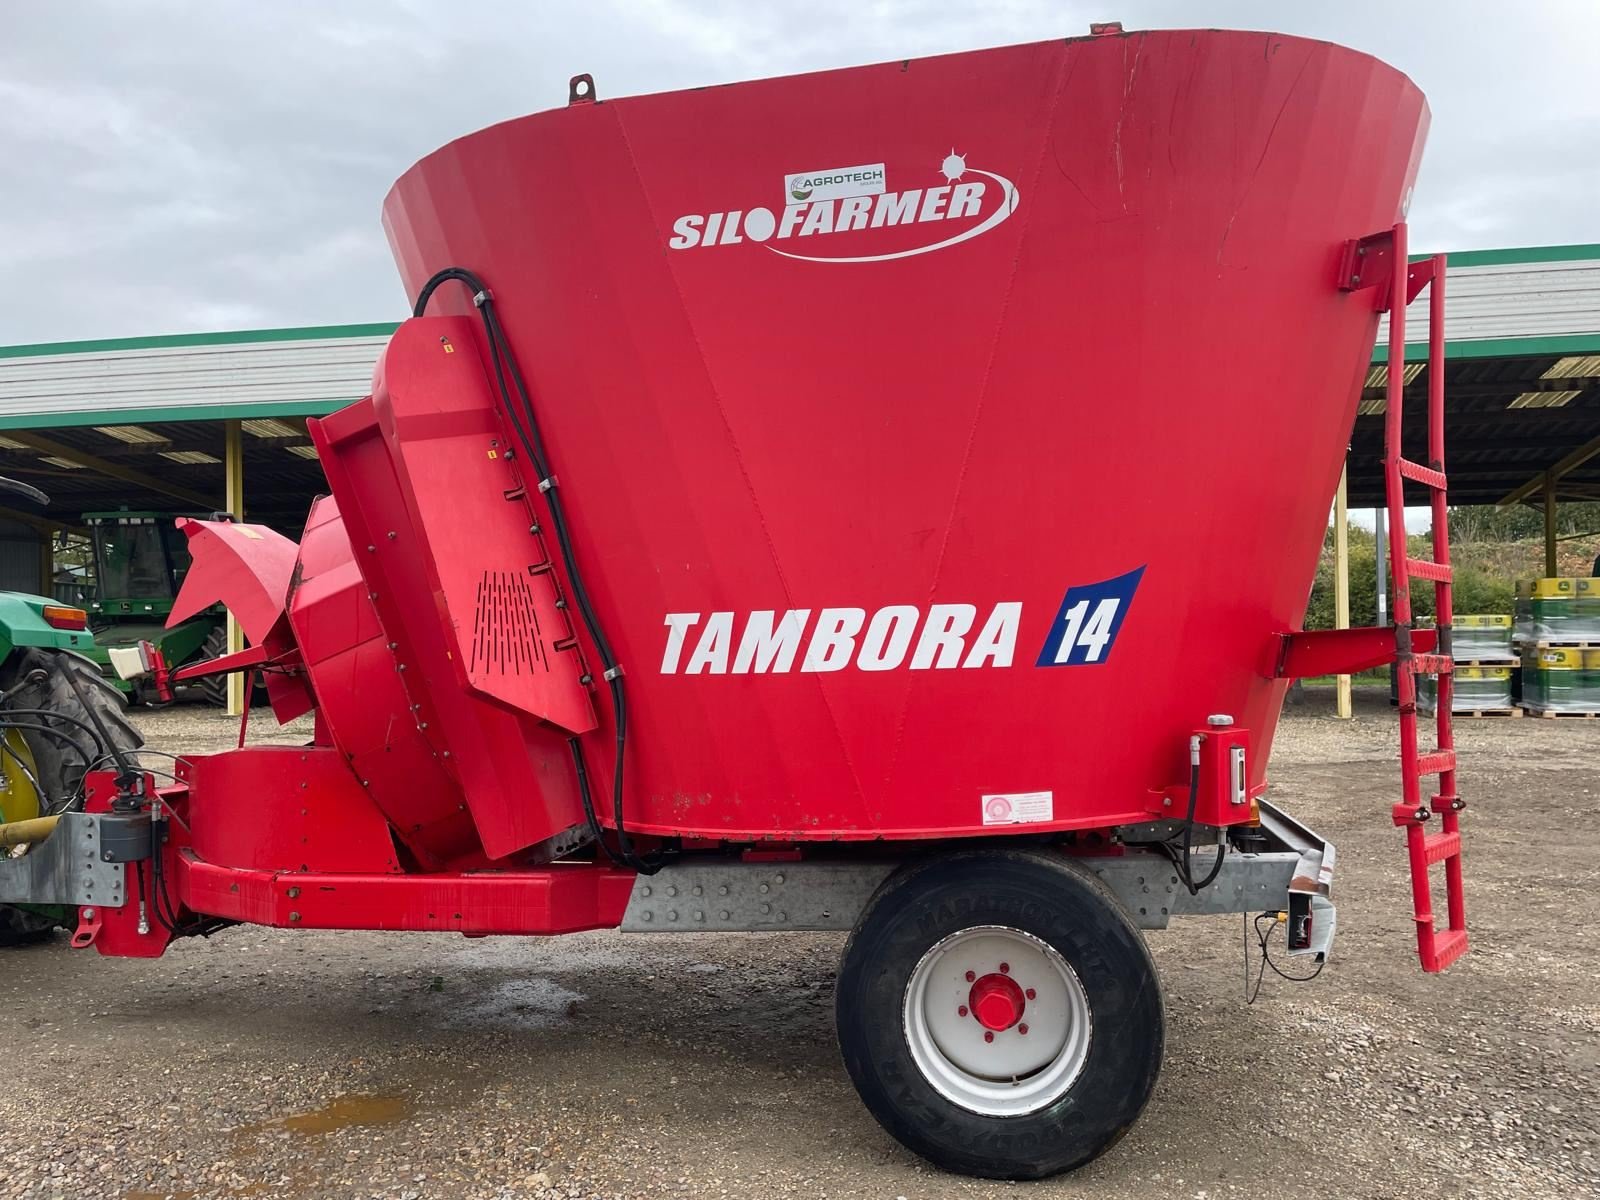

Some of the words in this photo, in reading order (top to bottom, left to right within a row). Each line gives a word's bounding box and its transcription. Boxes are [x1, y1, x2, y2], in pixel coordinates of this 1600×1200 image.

[803, 170, 883, 188] AGROTECH
[669, 183, 986, 250] SILOFARMER
[660, 602, 1023, 674] TAMBORA
[1055, 598, 1121, 664] 14
[915, 894, 1060, 935] MARATHON
